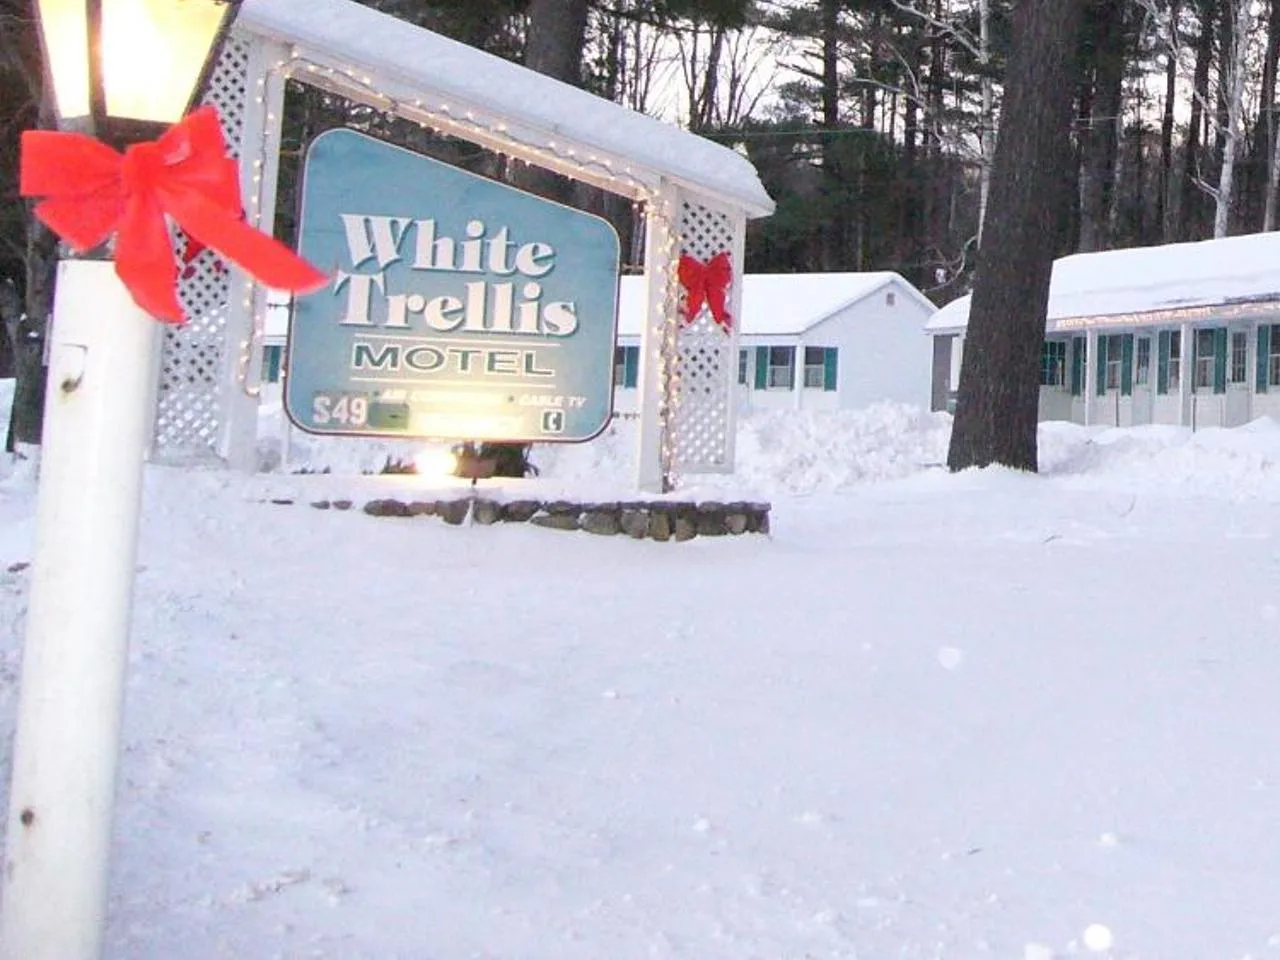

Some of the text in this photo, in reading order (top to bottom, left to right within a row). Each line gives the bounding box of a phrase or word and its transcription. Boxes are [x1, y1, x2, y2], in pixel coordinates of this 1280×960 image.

[338, 213, 556, 276] White
[334, 270, 579, 337] Trellis
[350, 343, 556, 377] MOTEL
[565, 395, 588, 409] TV
